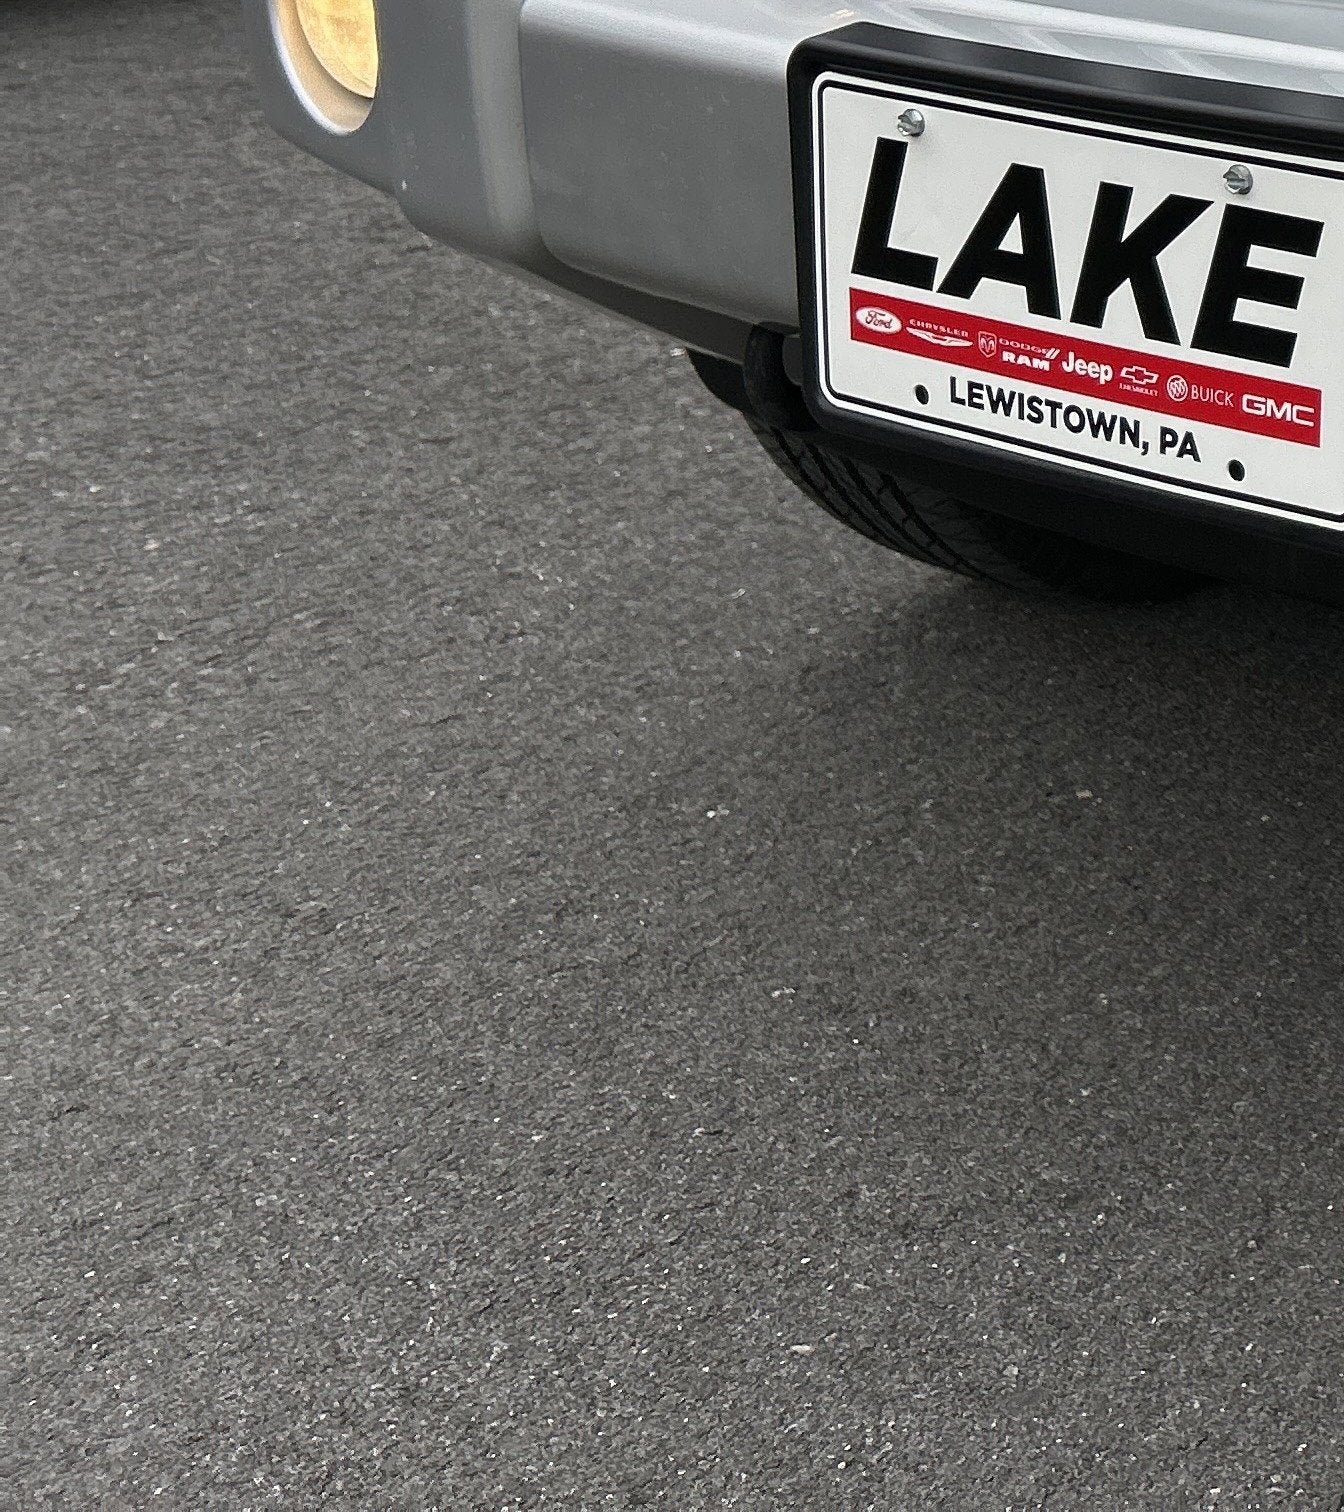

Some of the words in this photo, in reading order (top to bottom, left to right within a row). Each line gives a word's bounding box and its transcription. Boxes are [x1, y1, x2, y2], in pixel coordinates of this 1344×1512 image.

[851, 137, 1325, 368] LAKE
[865, 309, 892, 330] Ford
[1001, 350, 1050, 372] RAM
[1061, 351, 1114, 385] Jeep
[1190, 385, 1235, 408] BUICK
[1241, 392, 1316, 427] GMC
[949, 375, 1150, 456] LEWISTOWN,
[1159, 426, 1202, 463] PA
